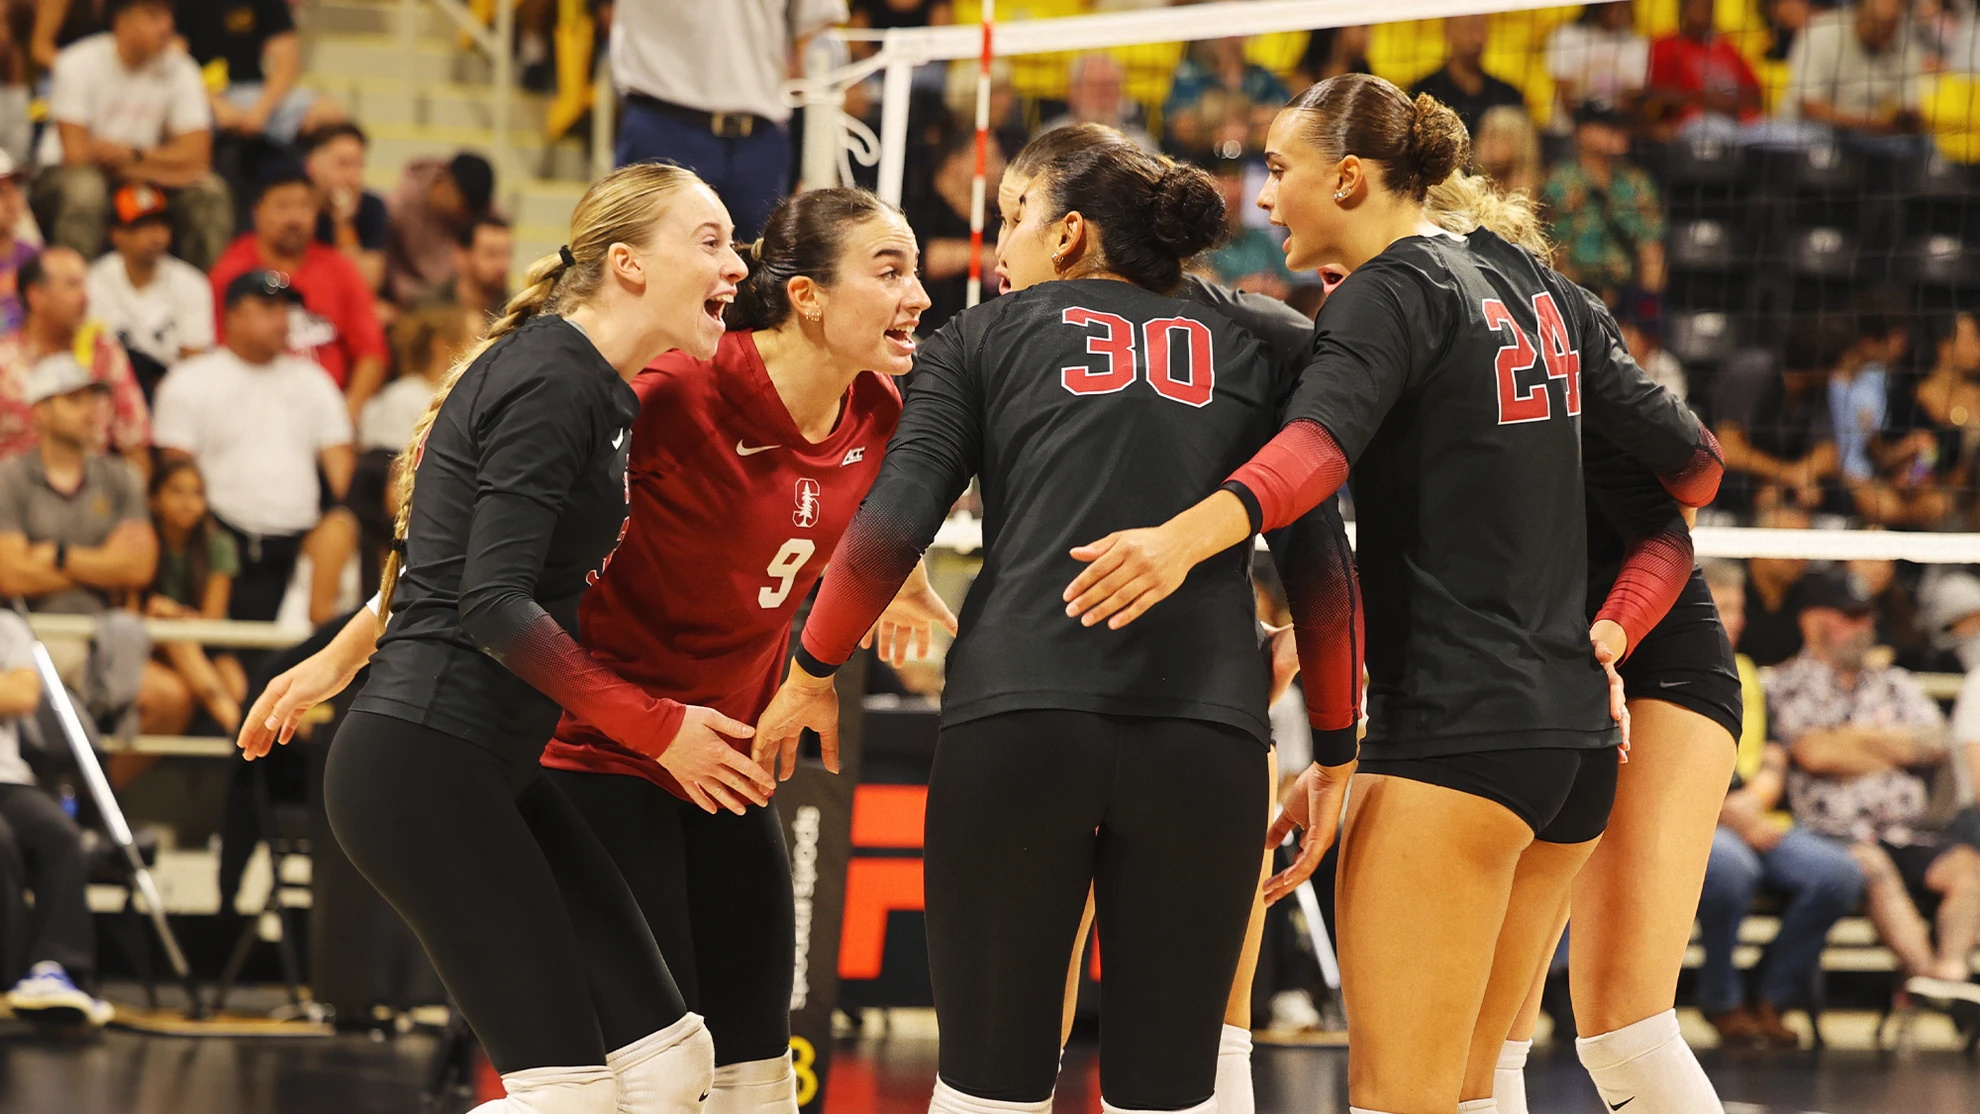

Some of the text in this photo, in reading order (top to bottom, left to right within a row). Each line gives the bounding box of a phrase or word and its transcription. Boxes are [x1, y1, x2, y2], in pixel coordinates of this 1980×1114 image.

[1061, 306, 1215, 408] 30
[1482, 291, 1581, 425] 24
[841, 446, 866, 466] ACC
[758, 538, 816, 608] 9
